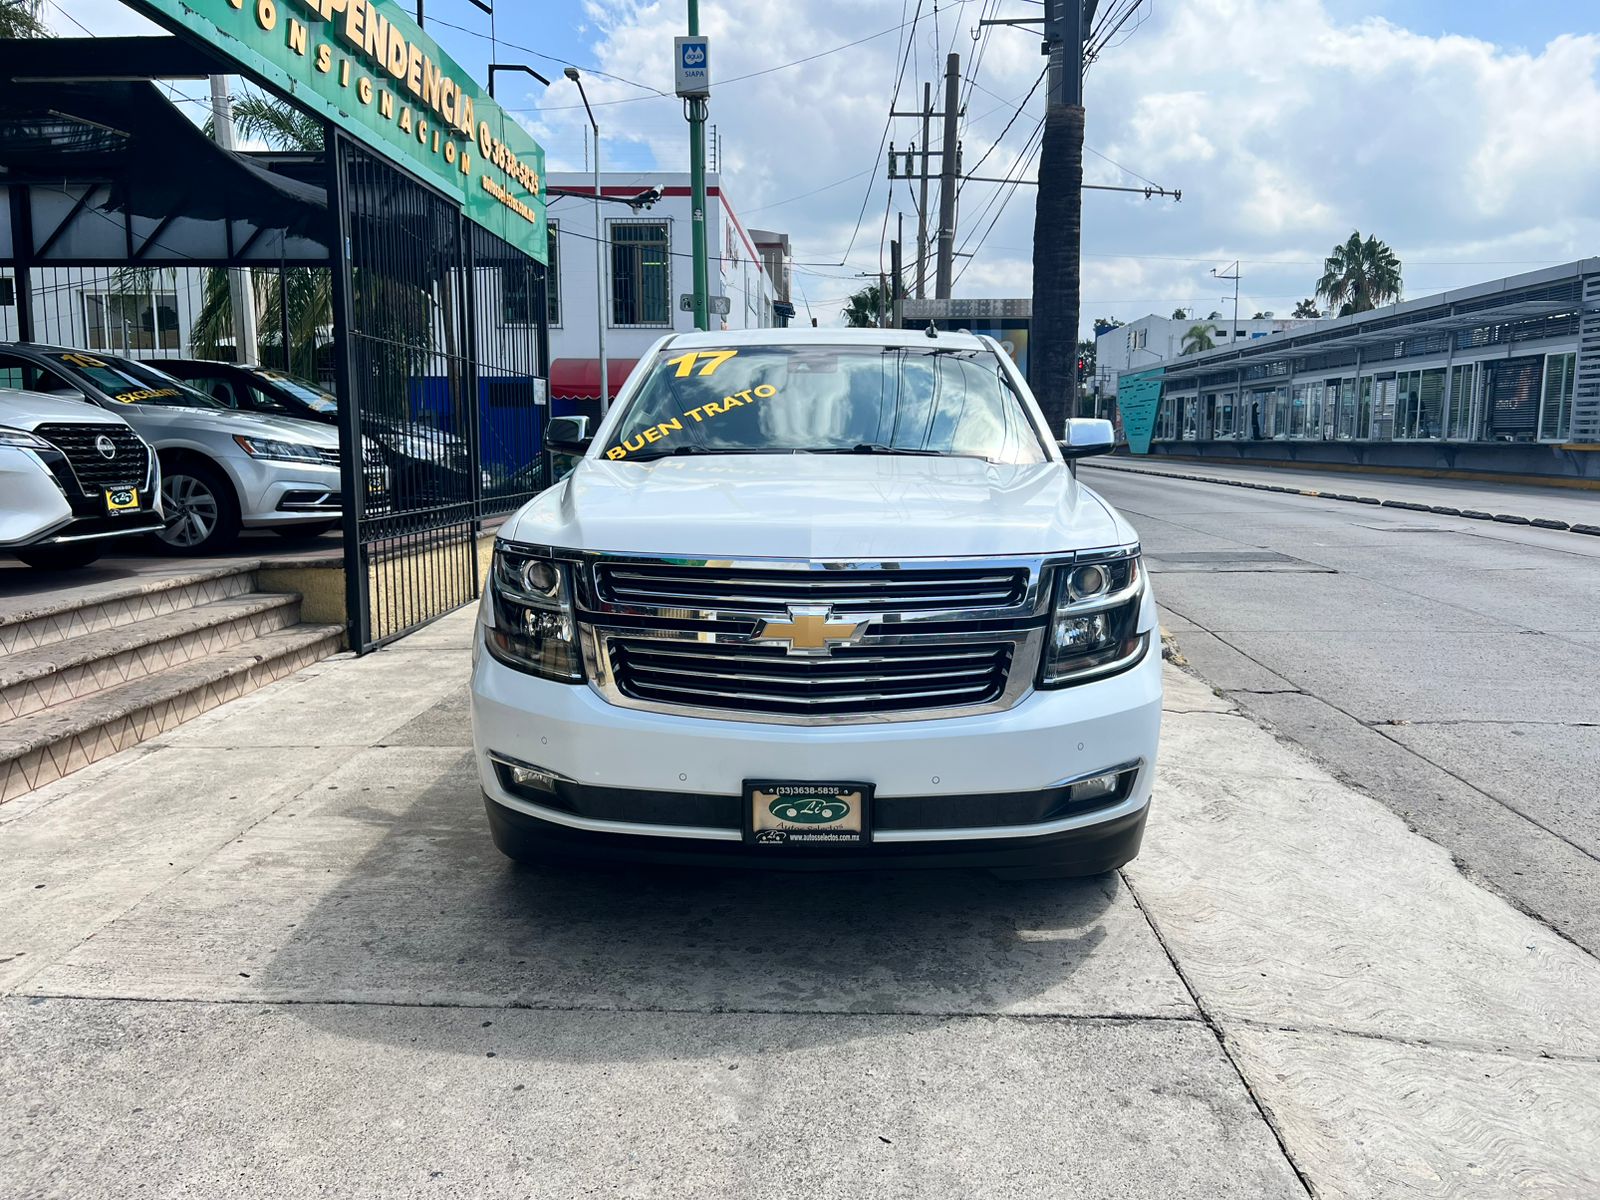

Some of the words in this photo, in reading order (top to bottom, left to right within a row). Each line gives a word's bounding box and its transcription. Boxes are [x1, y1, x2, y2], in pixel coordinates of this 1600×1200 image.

[666, 349, 739, 378] 17
[606, 417, 684, 461] BUEN
[683, 384, 777, 423] TRATO
[776, 786, 840, 796] (33)3638-5835
